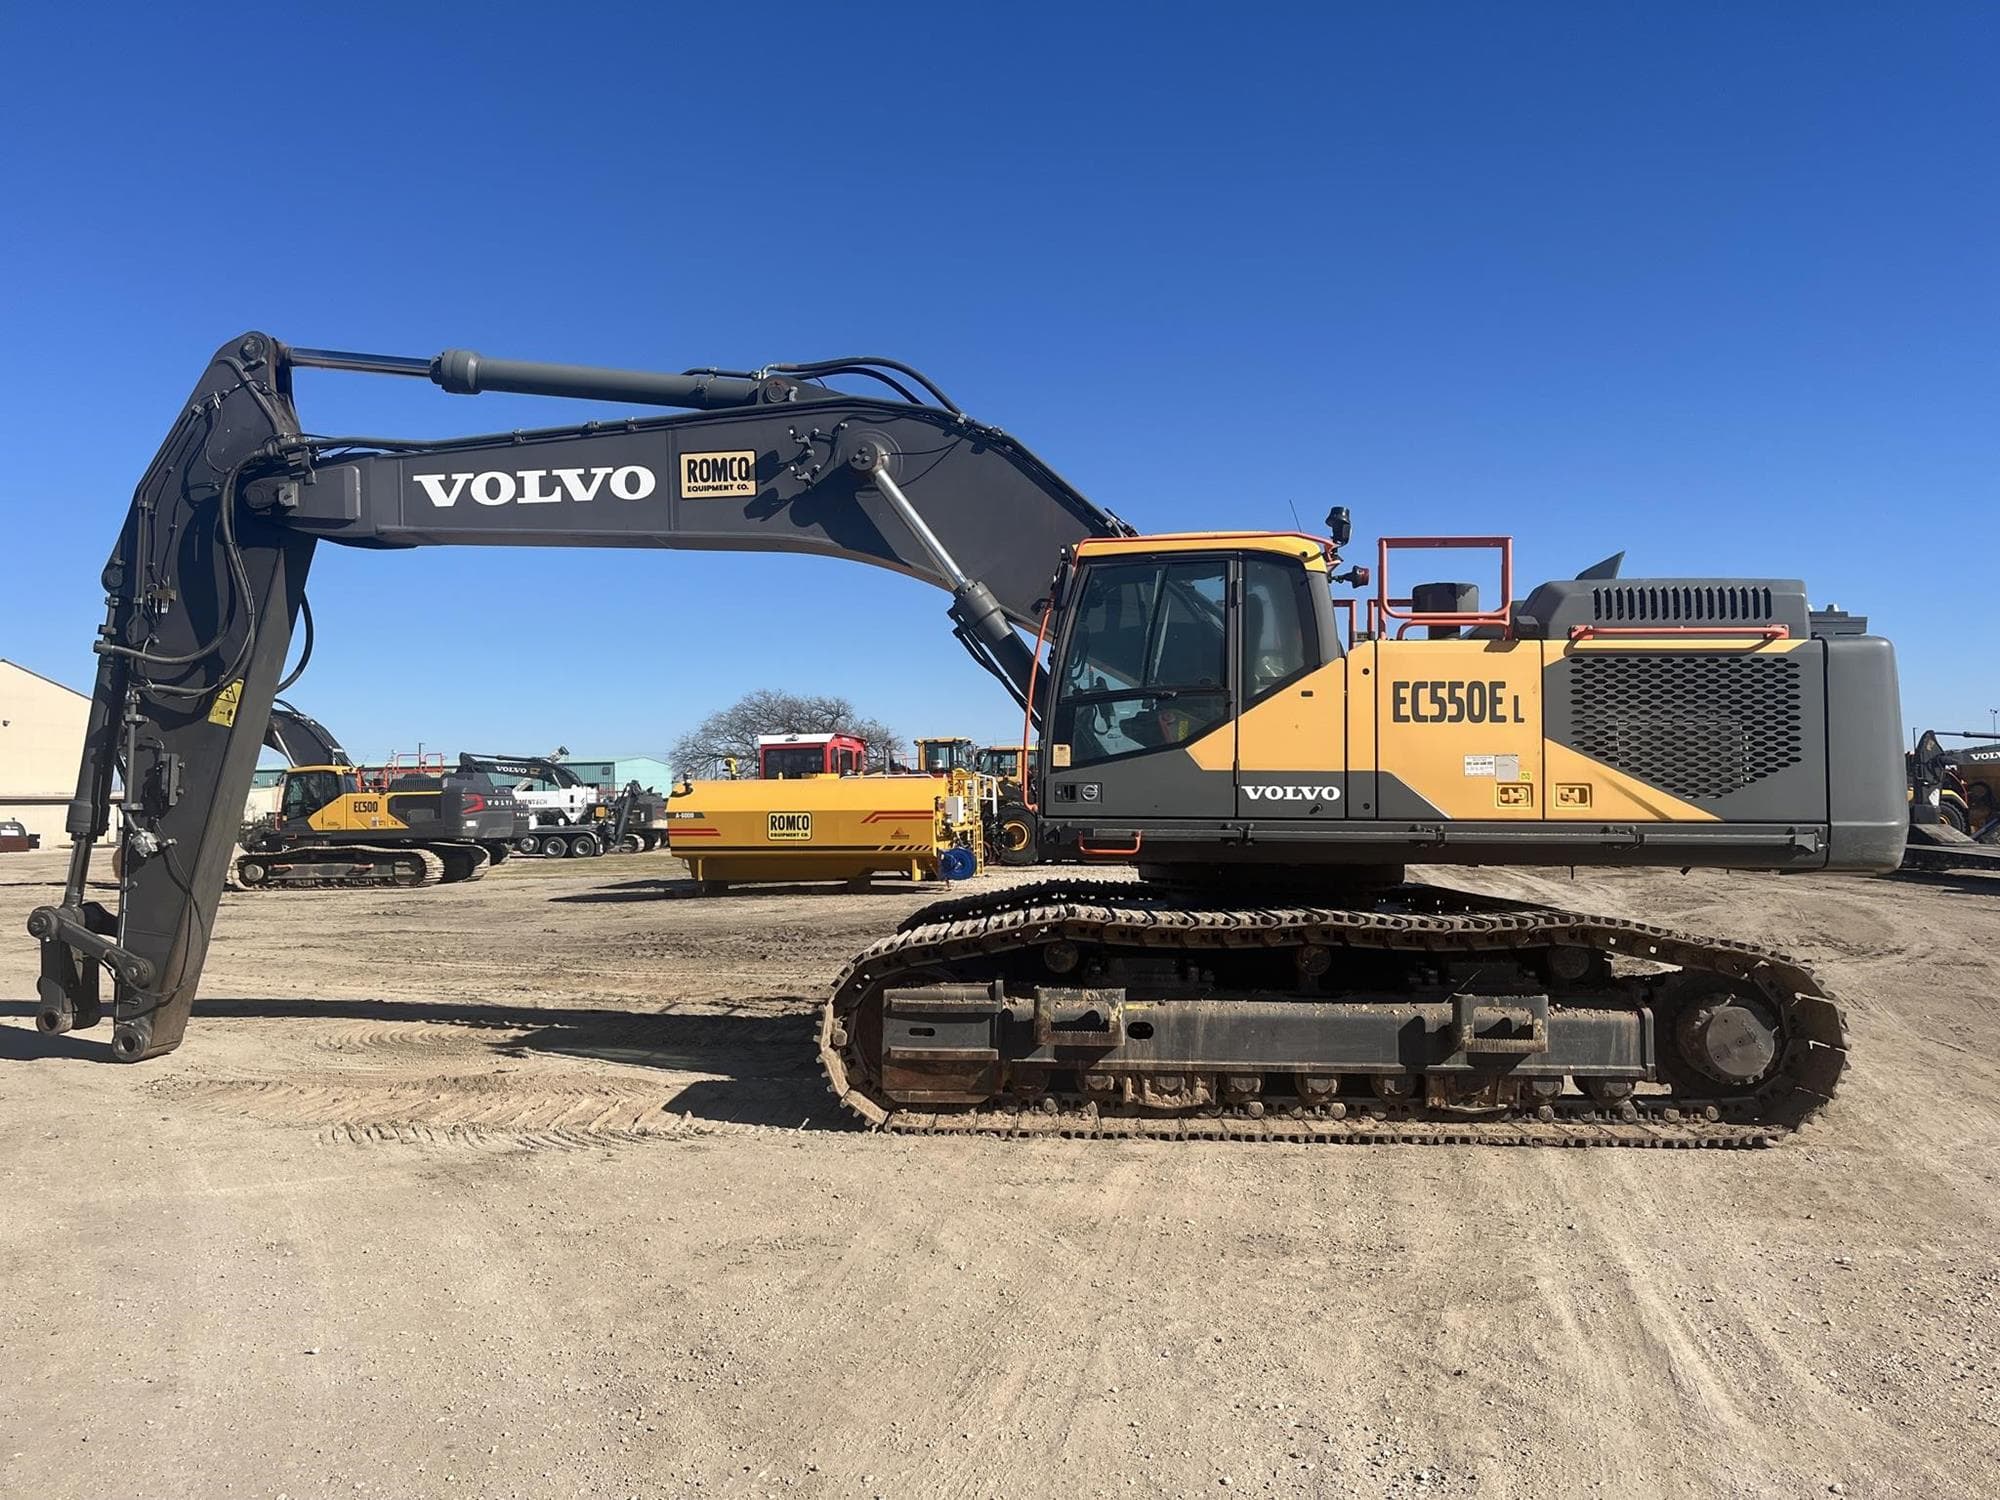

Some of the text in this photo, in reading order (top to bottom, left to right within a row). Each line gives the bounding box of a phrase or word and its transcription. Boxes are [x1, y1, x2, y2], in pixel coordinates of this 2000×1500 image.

[687, 457, 750, 483] ROMCO
[412, 465, 657, 508] VOLVO
[687, 484, 734, 493] EQUIPMENT
[495, 765, 527, 774] VOLVO
[1241, 785, 1341, 801] VOLVO
[353, 801, 378, 813] EC500
[770, 815, 809, 831] ROMCO
